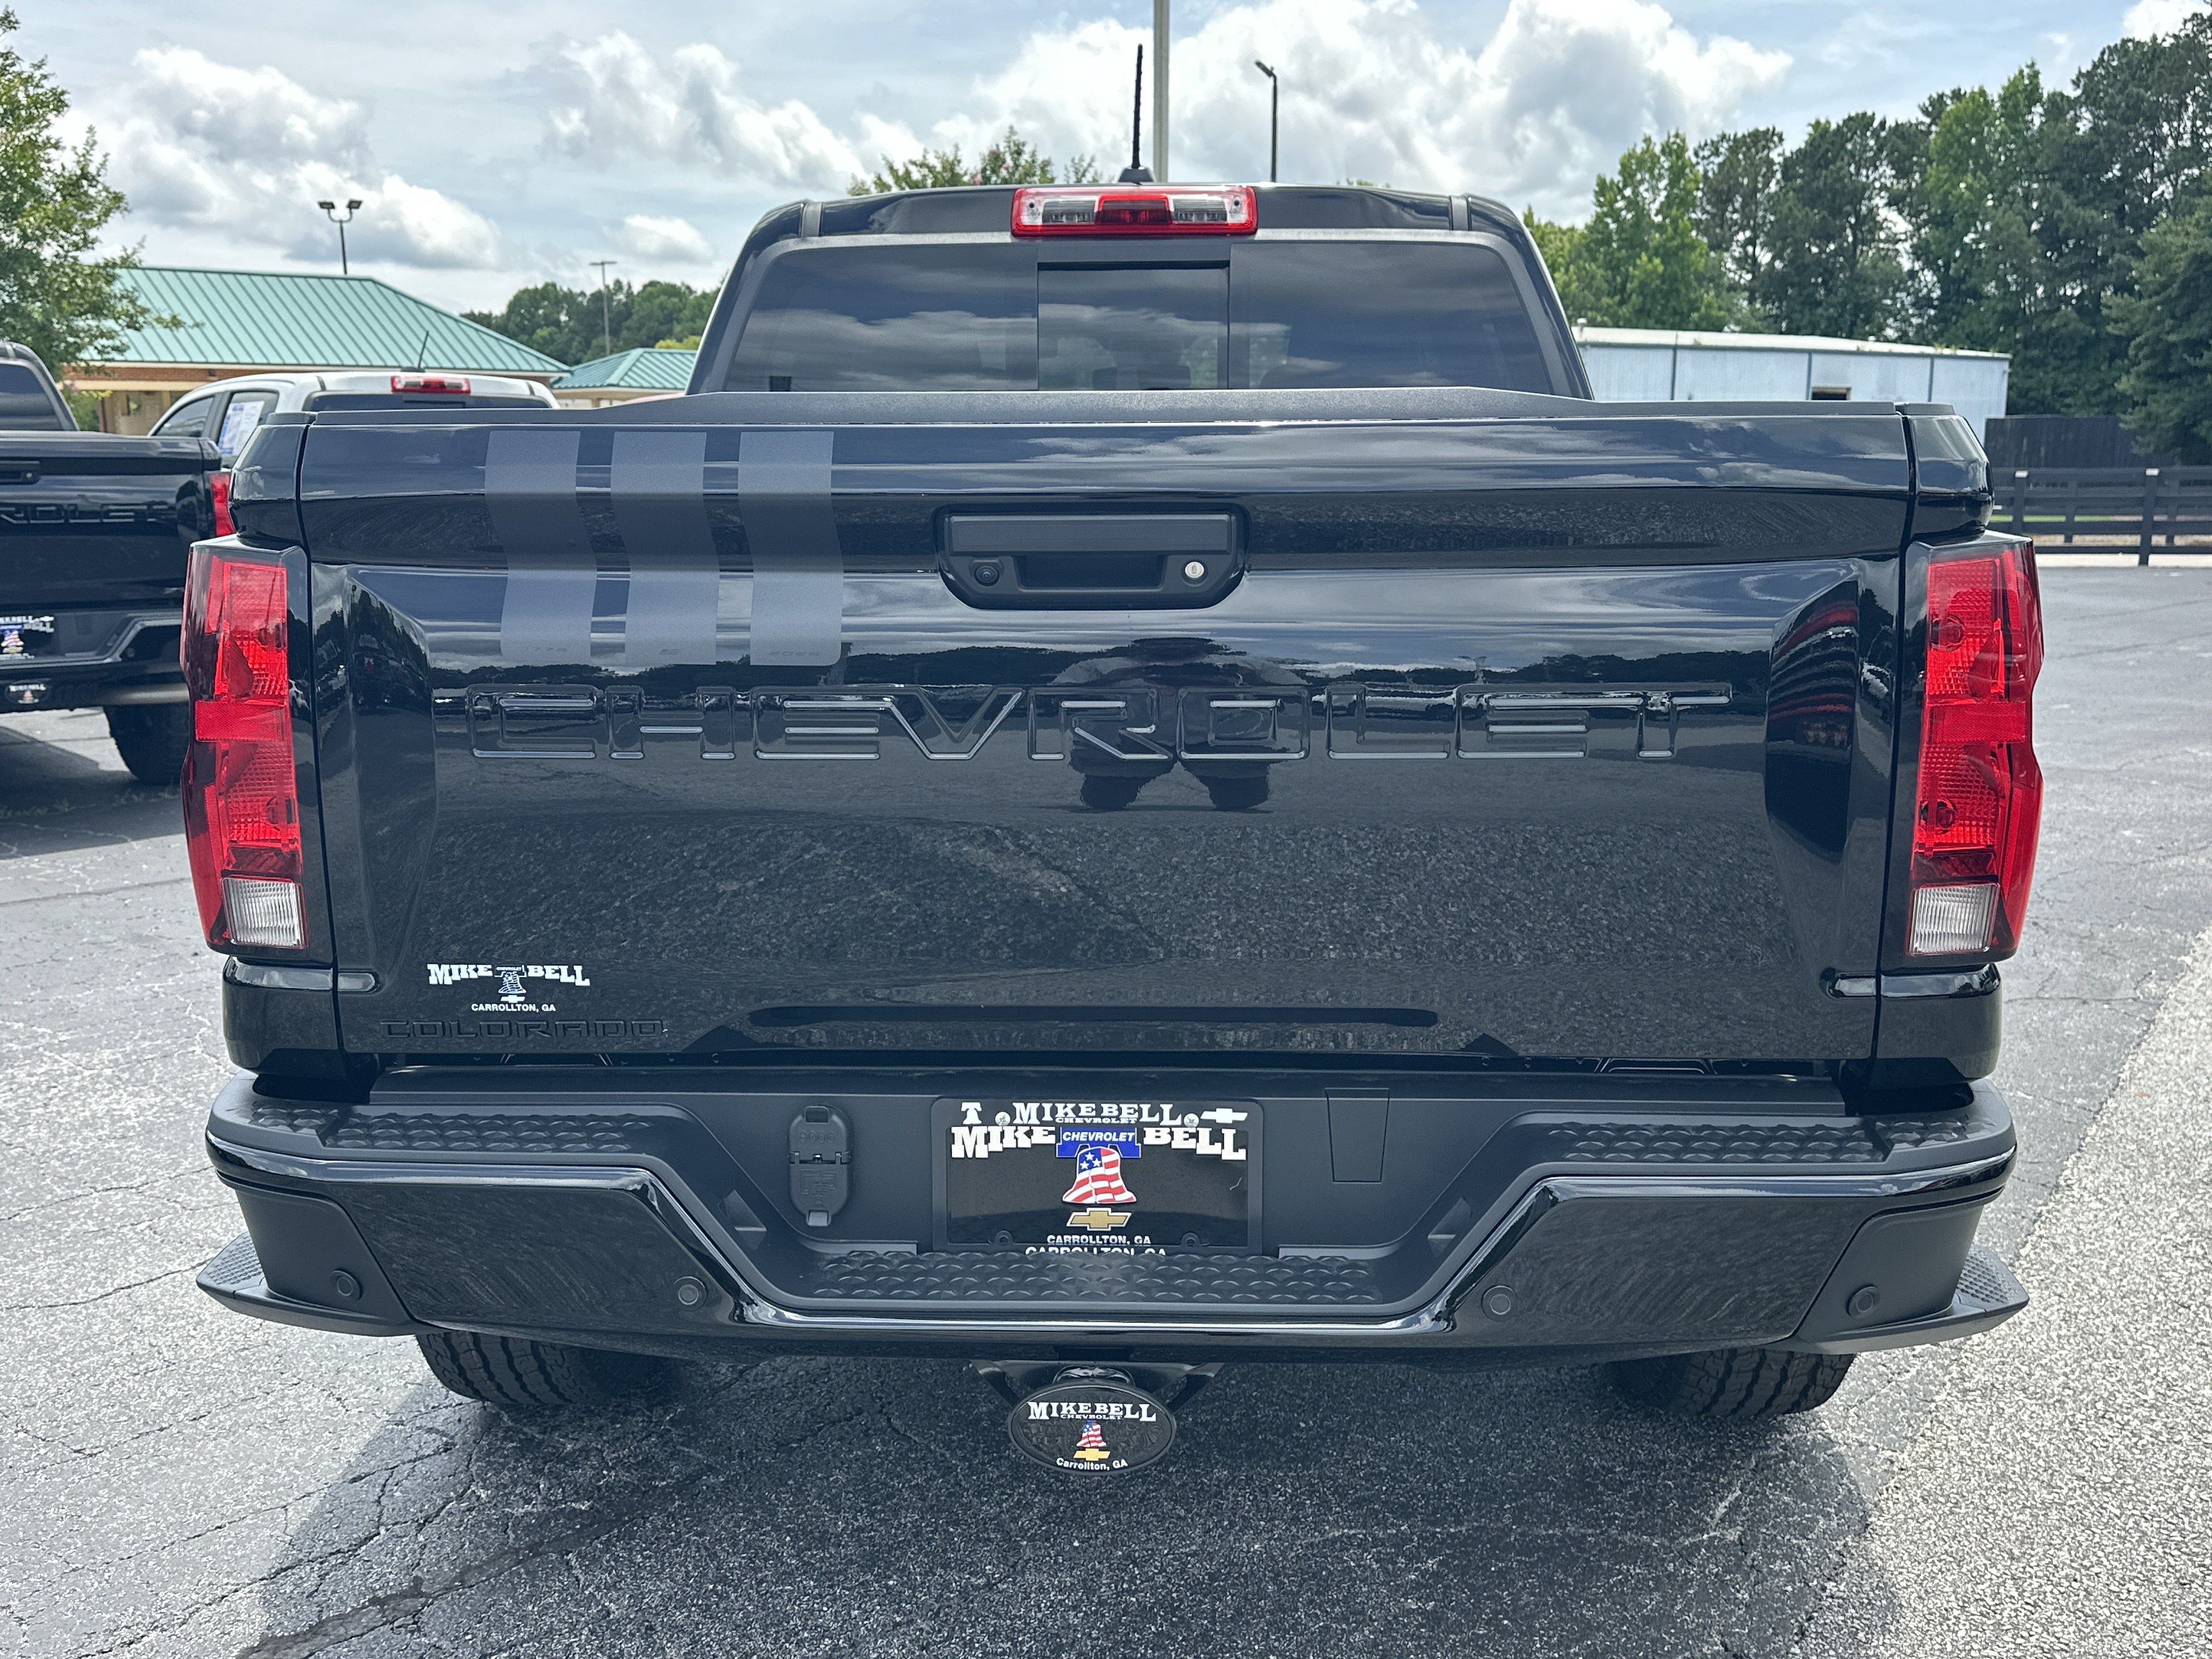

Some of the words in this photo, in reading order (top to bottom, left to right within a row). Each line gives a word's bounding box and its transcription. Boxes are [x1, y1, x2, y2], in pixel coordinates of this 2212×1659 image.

[466, 682, 1733, 760] CHEVROLET
[427, 964, 493, 985] MIKE
[527, 964, 590, 986] BELL
[471, 1003, 539, 1013] CARROLLTON,
[380, 1019, 665, 1039] COLORADO
[1012, 1102, 1096, 1124] MIKE
[1101, 1103, 1182, 1125] BELL
[951, 1126, 1056, 1159] MIKE
[1143, 1127, 1246, 1160] BELL
[1062, 1131, 1135, 1142] CHEVROLET
[1047, 1234, 1130, 1244] CARROLLTON,
[1133, 1235, 1151, 1244] GA
[1028, 1402, 1091, 1420] MIKE
[1094, 1403, 1156, 1421] BELL
[1056, 1457, 1110, 1470] Carrollton,
[1113, 1458, 1128, 1469] GA
